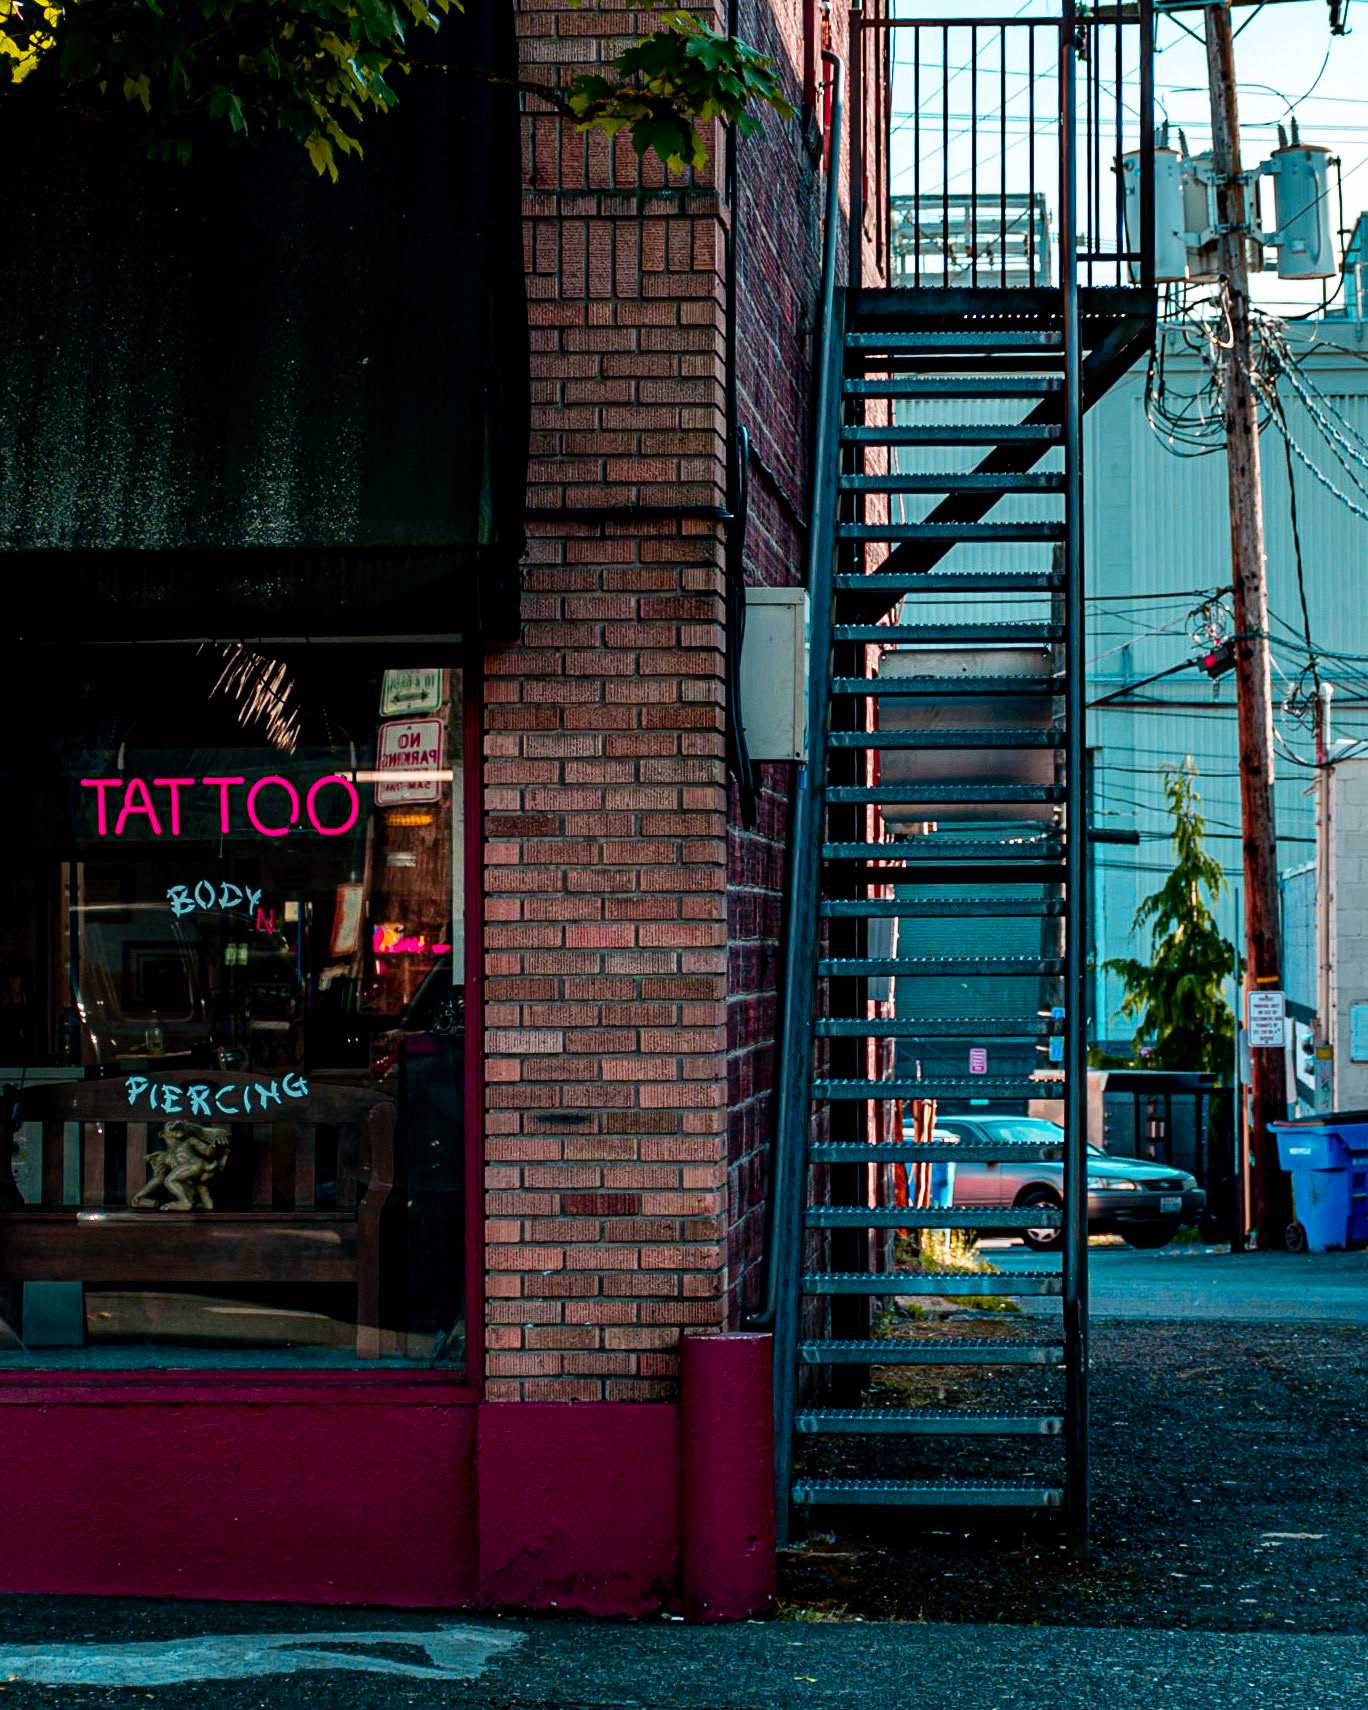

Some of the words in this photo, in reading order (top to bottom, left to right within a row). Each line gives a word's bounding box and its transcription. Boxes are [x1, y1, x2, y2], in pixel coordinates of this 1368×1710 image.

[81, 775, 359, 837] TATTOO
[166, 879, 262, 918] BODY
[125, 1072, 309, 1117] PIERCING
